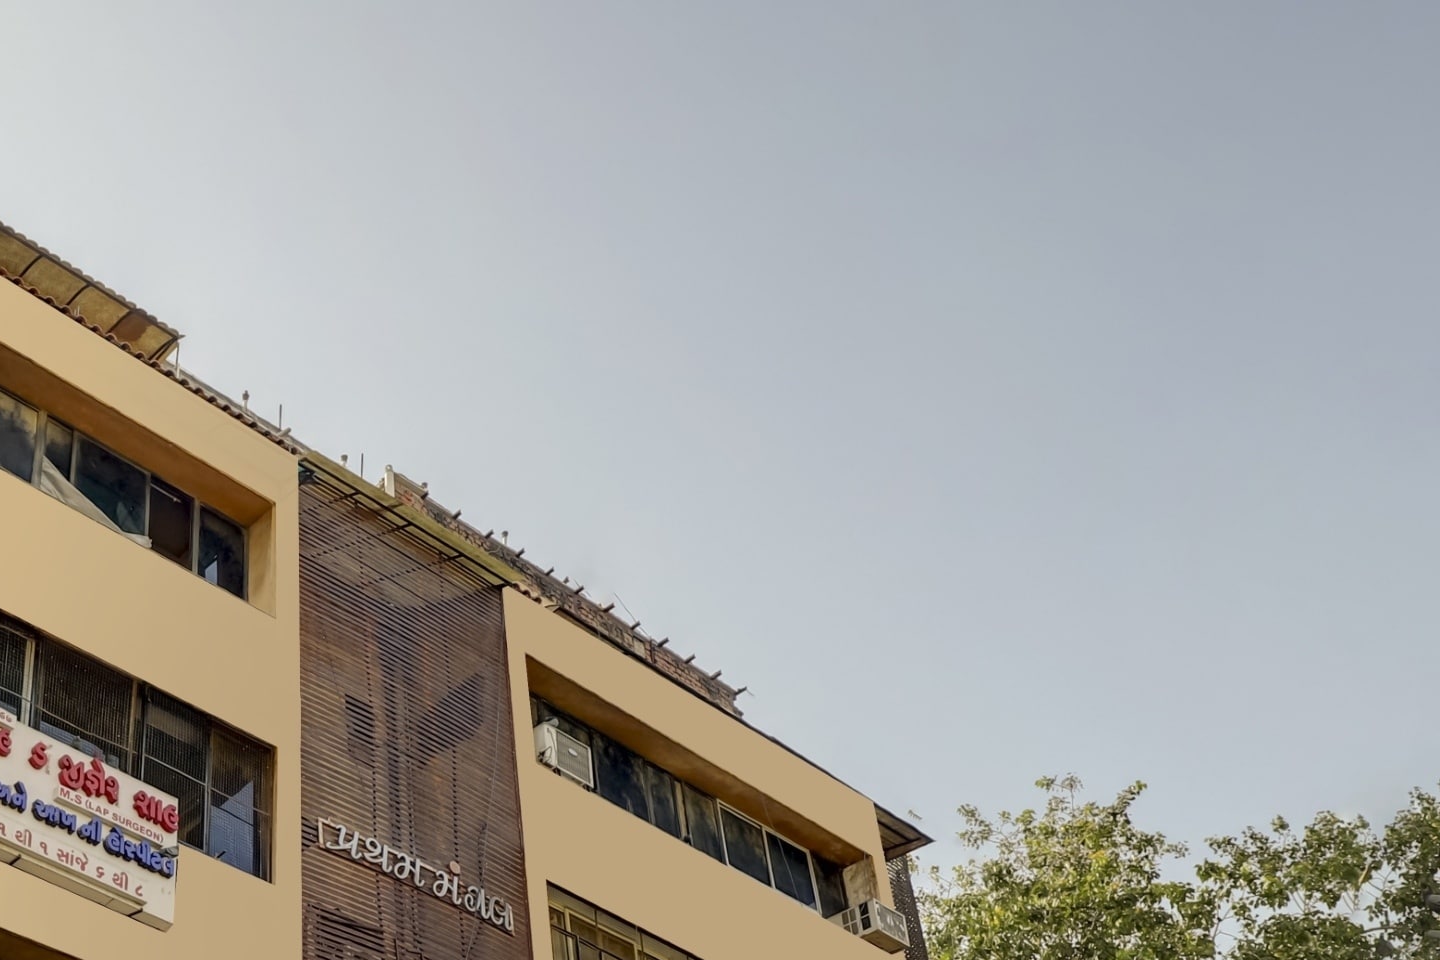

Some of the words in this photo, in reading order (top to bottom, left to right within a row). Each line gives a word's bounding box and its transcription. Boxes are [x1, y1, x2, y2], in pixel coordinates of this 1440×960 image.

[77, 817, 102, 846] ની
[85, 798, 109, 816] (LAP
[112, 812, 164, 843] SURGEON)
[133, 788, 179, 833] શાહ
[14, 828, 33, 850] થી
[57, 846, 90, 875] સાંજે
[112, 871, 129, 894] થી
